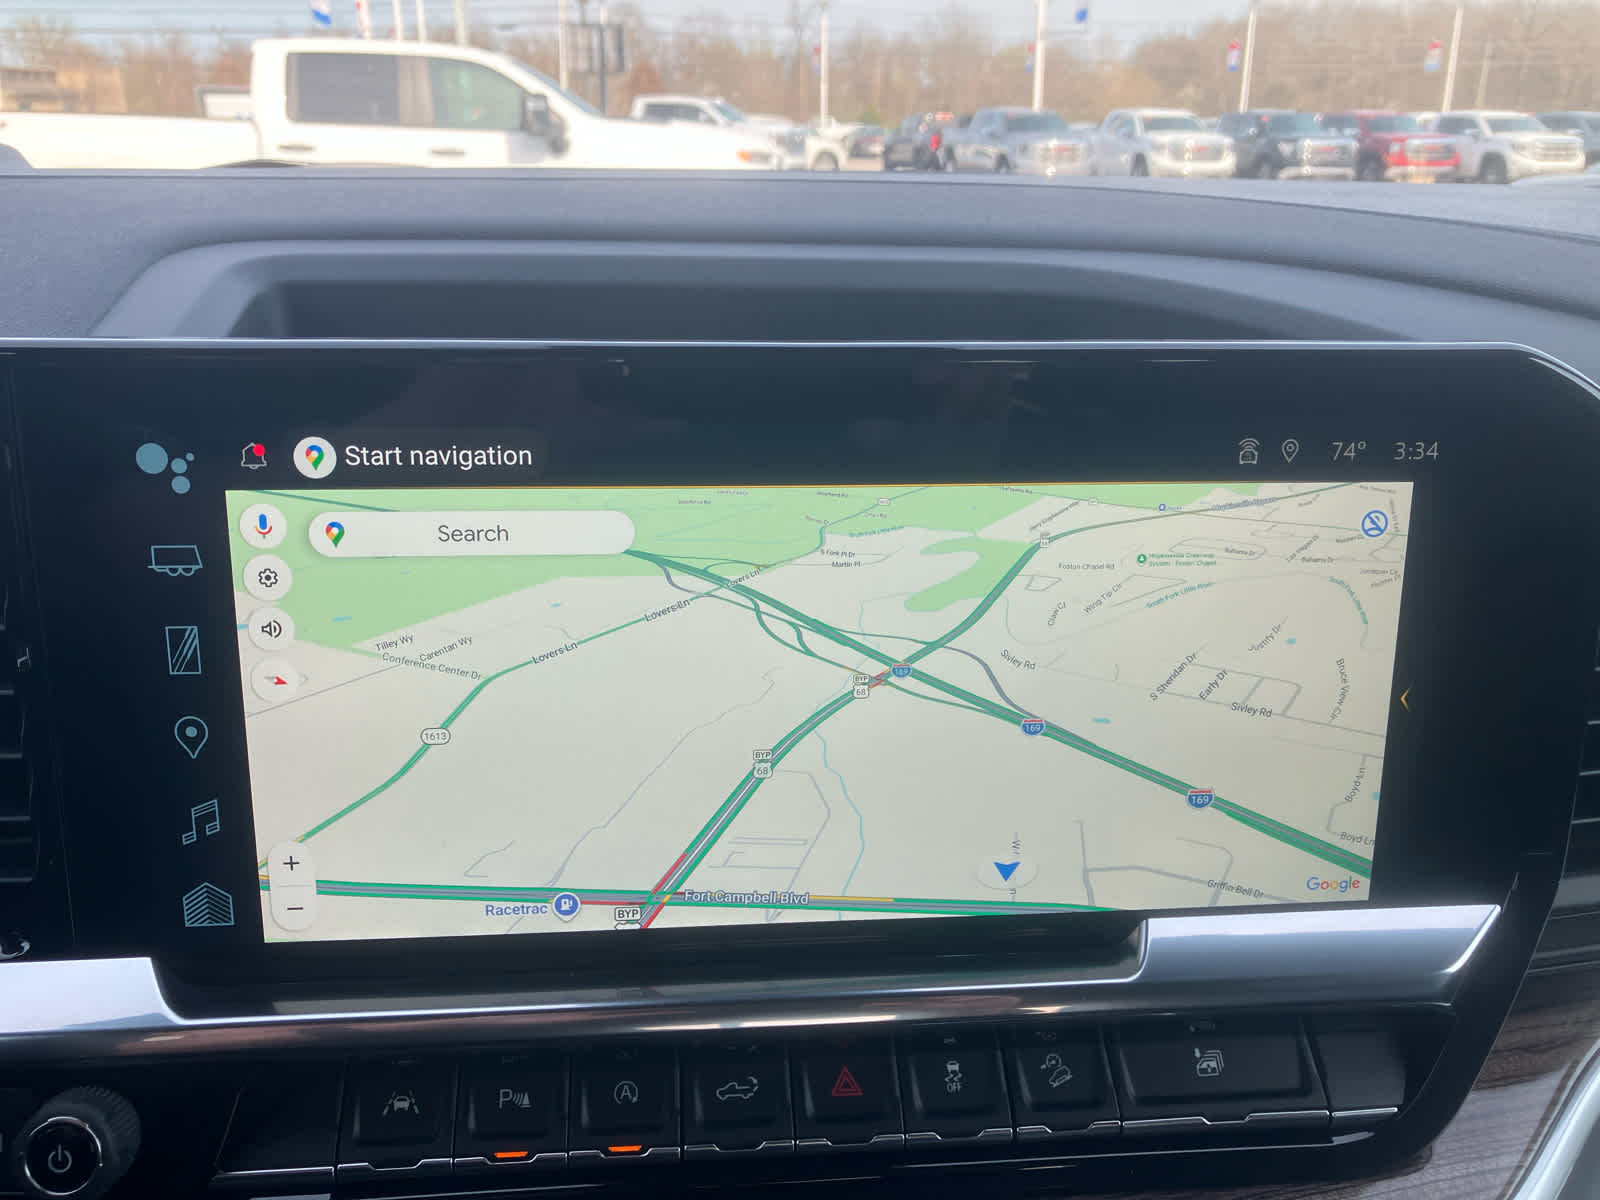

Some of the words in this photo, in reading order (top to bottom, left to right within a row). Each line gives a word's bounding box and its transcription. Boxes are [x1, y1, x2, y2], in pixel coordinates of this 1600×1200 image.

[344, 445, 402, 466] Start
[410, 445, 533, 470] navigation
[1393, 441, 1439, 461] 3:34
[437, 525, 509, 542] Search
[726, 574, 750, 589] Lovers
[750, 567, 761, 577] Ln
[644, 606, 678, 622] Lovers
[678, 599, 691, 609] Ln
[376, 640, 398, 651] Tilley
[400, 634, 414, 645] Wy
[419, 642, 458, 662] Carentan
[458, 636, 472, 646] Wy
[531, 645, 563, 665] Lovers
[563, 641, 578, 652] Ln
[382, 652, 436, 671] Conference
[438, 663, 469, 678] Center
[470, 671, 481, 681] Dr
[1024, 660, 1036, 670] Rd
[1156, 662, 1188, 695] Sheridan
[1186, 652, 1198, 664] Dr
[1336, 658, 1348, 684] Bruce
[855, 688, 866, 696] 68
[1198, 679, 1220, 701] Early
[1216, 668, 1229, 681] Dr
[1338, 685, 1350, 706] View
[1231, 702, 1257, 717] Sivley
[1259, 708, 1272, 718] Rd
[424, 732, 447, 741] 1613
[1025, 724, 1041, 733] 169
[755, 751, 771, 759] BYP
[756, 767, 769, 775] 68
[1345, 778, 1362, 802] Boyd
[1357, 767, 1366, 779] Ln
[1191, 795, 1209, 804] 169
[1340, 831, 1363, 844] Boyd
[1235, 885, 1253, 896] Bell
[1254, 888, 1265, 898] Dr
[1306, 876, 1361, 893] Google
[684, 890, 712, 904] Fort
[714, 891, 777, 907] Campbell
[779, 891, 809, 905] Blvd
[485, 903, 548, 917] Racetrac
[617, 909, 639, 920] BYP
[946, 1081, 963, 1093] OFF
